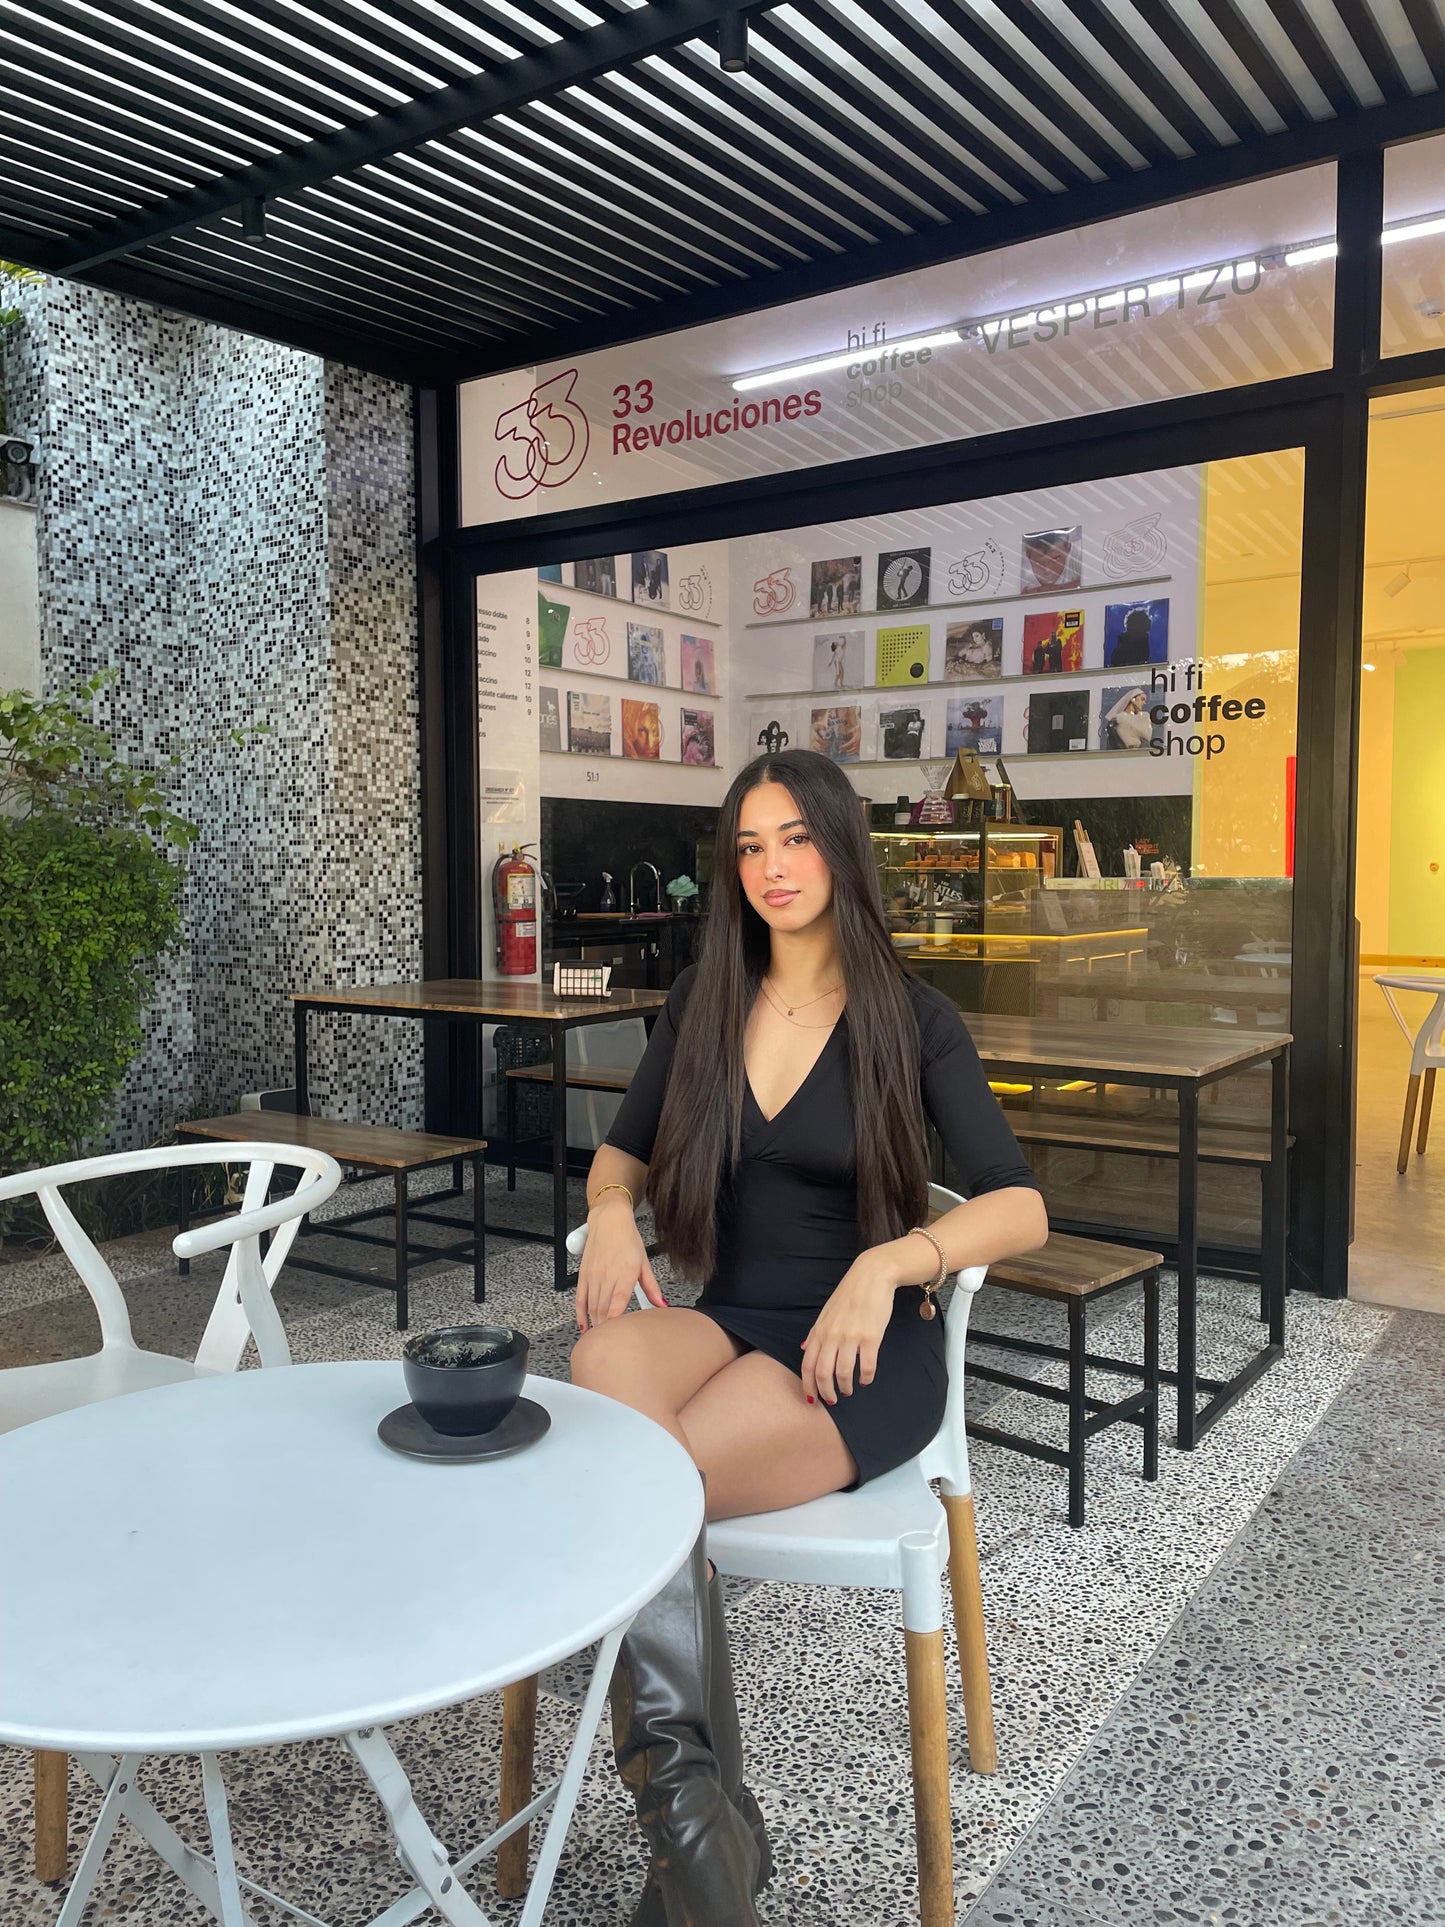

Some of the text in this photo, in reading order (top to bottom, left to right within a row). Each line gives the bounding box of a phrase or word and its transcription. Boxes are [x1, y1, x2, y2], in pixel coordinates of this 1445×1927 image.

[979, 254, 1262, 355] VESPER TZU
[847, 321, 886, 352] hi fi
[846, 347, 932, 380] coffee
[612, 379, 655, 419] 33
[846, 381, 903, 408] shop
[612, 389, 823, 456] Revoluciones
[1151, 663, 1203, 693] hi fi
[1149, 694, 1266, 725] coffee
[1149, 731, 1226, 760] shop
